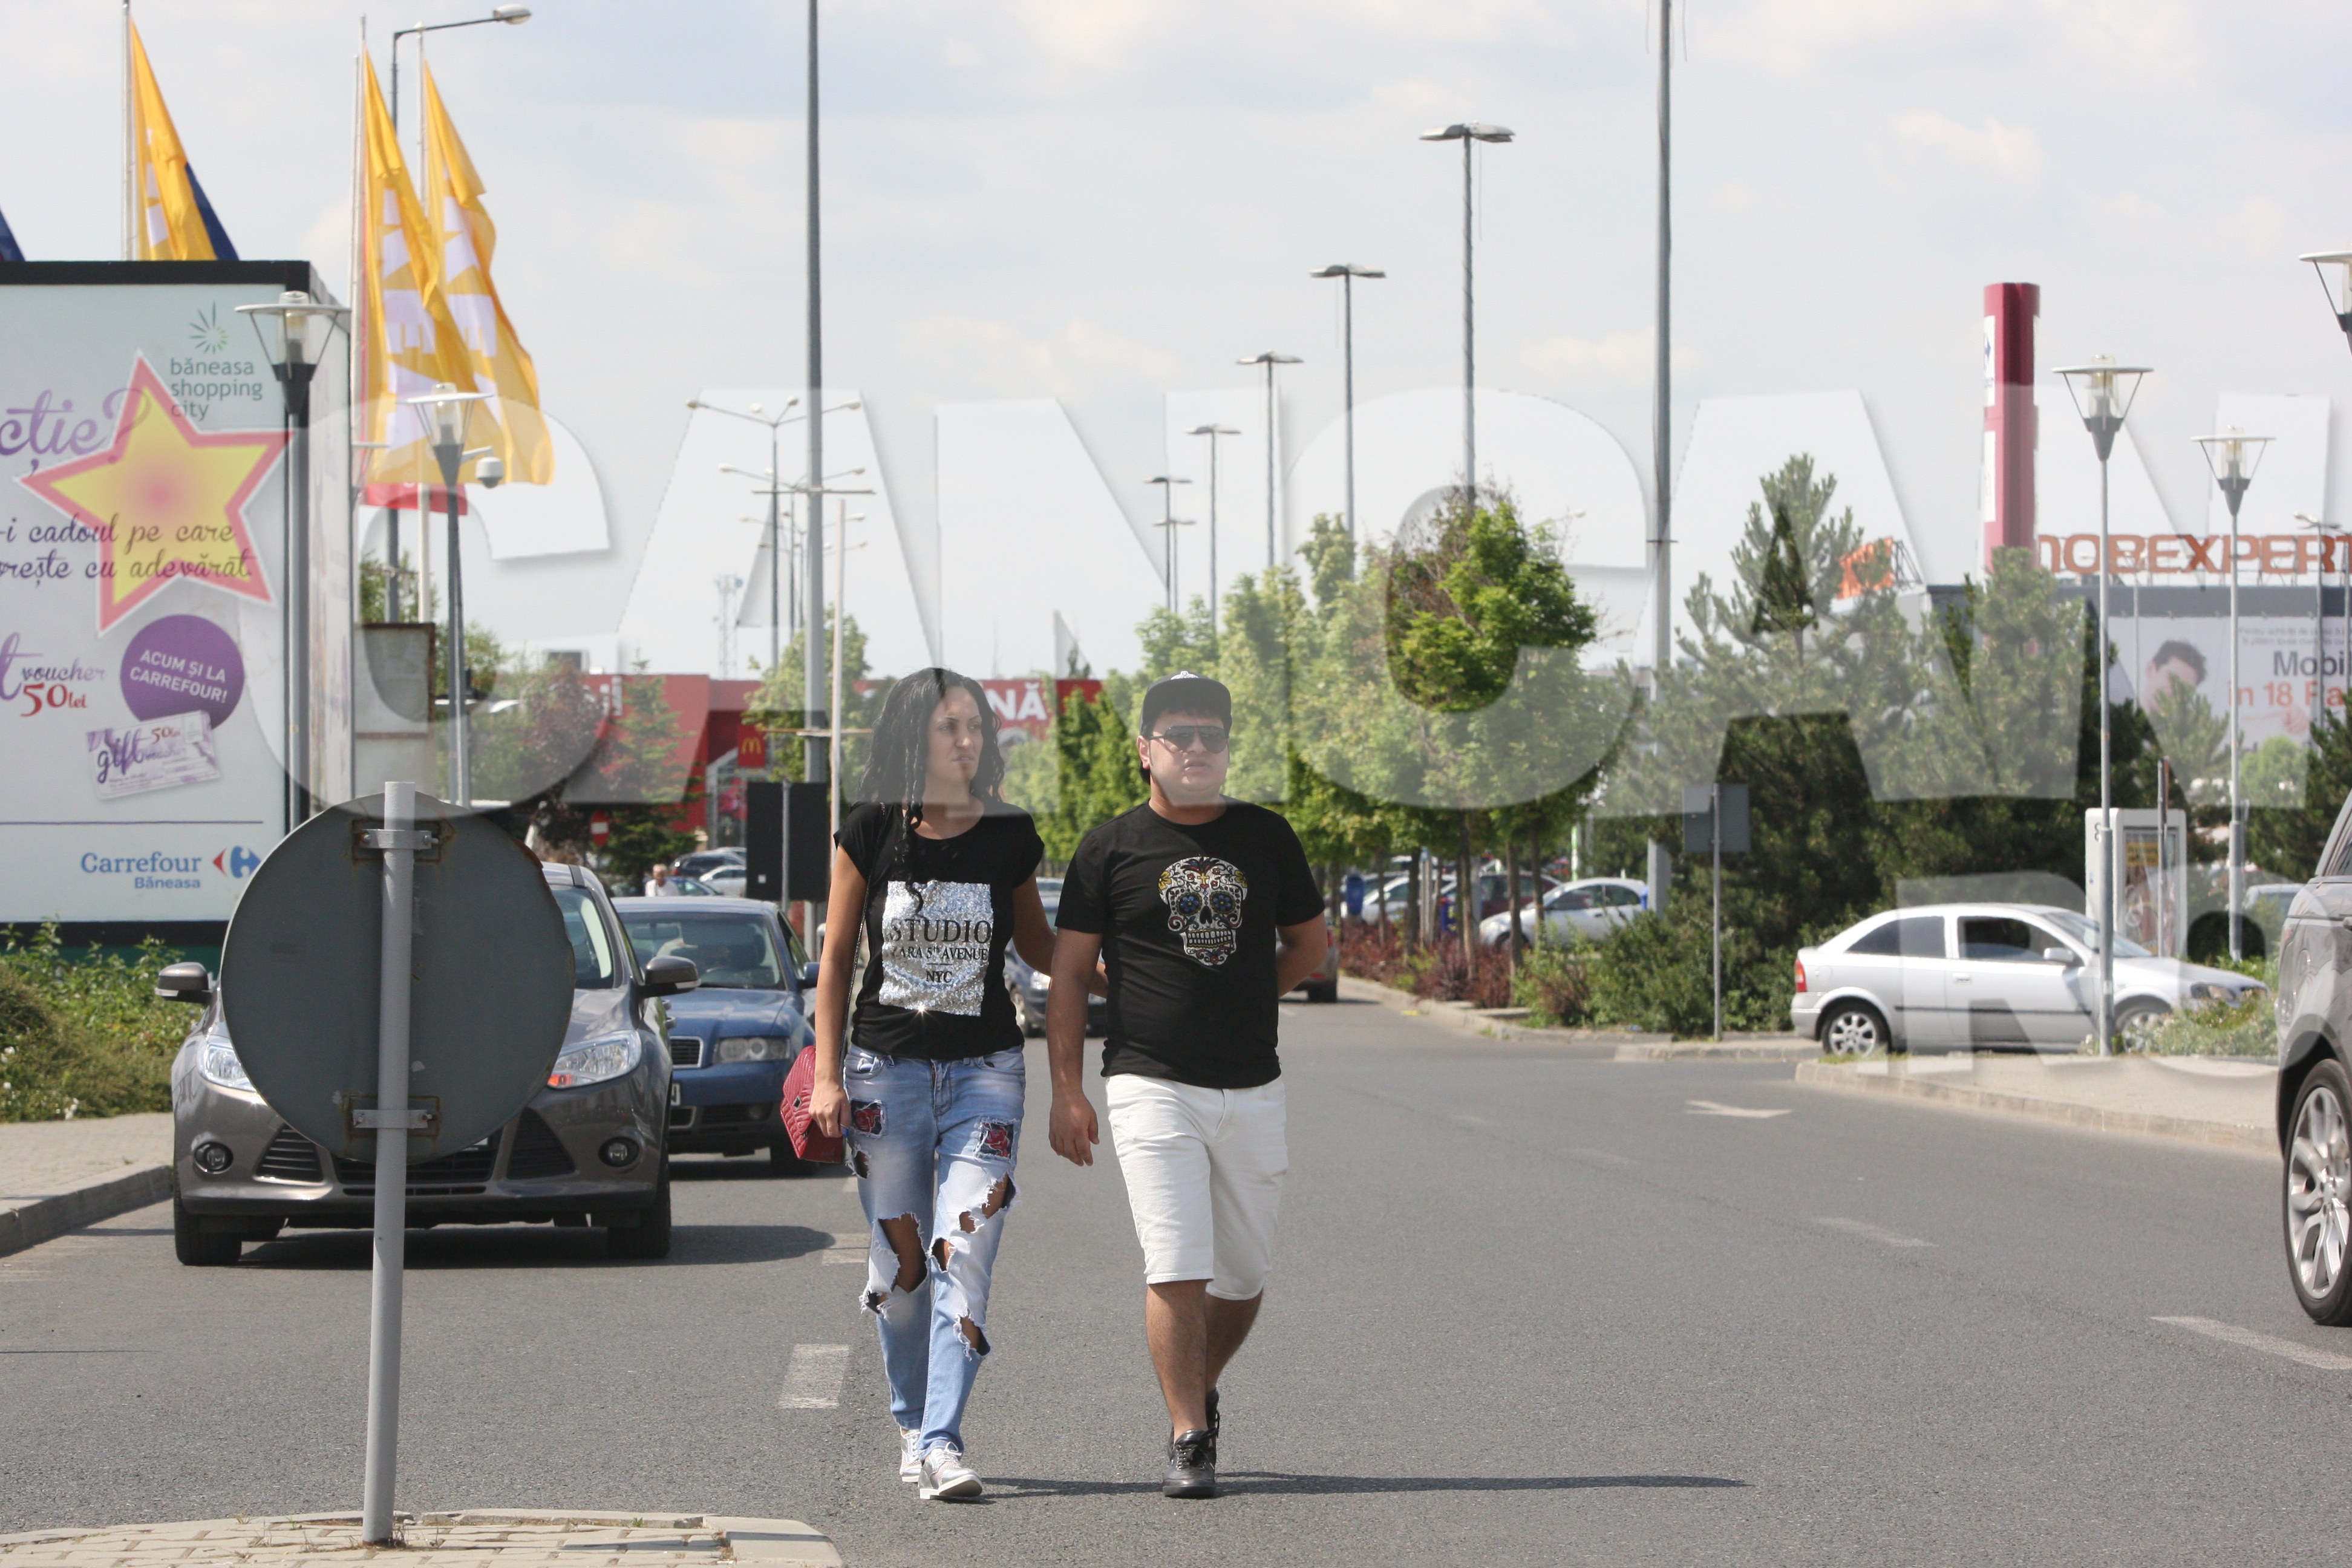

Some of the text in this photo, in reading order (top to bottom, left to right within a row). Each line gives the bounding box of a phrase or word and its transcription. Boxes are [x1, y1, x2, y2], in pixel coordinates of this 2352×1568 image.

[170, 358, 254, 375] băneasa
[171, 379, 263, 400] shopping
[171, 400, 209, 421] city
[29, 513, 119, 543] cadoul
[125, 524, 163, 555] pe
[175, 523, 237, 543] care
[2037, 534, 2352, 574] OBEXPER
[85, 561, 117, 578] cu
[22, 658, 107, 682] voucher
[140, 649, 185, 673] ACUM
[206, 663, 227, 684] LA
[2273, 650, 2352, 677] Mobi
[129, 665, 228, 704] CARREFOUR!
[2263, 681, 2293, 707] 18
[97, 728, 154, 784] gift
[80, 851, 202, 874] Carrefour
[134, 875, 201, 889] Băneasa
[889, 919, 992, 944] STUDIO
[942, 947, 989, 962] AVENUE
[926, 970, 953, 984] NYC
